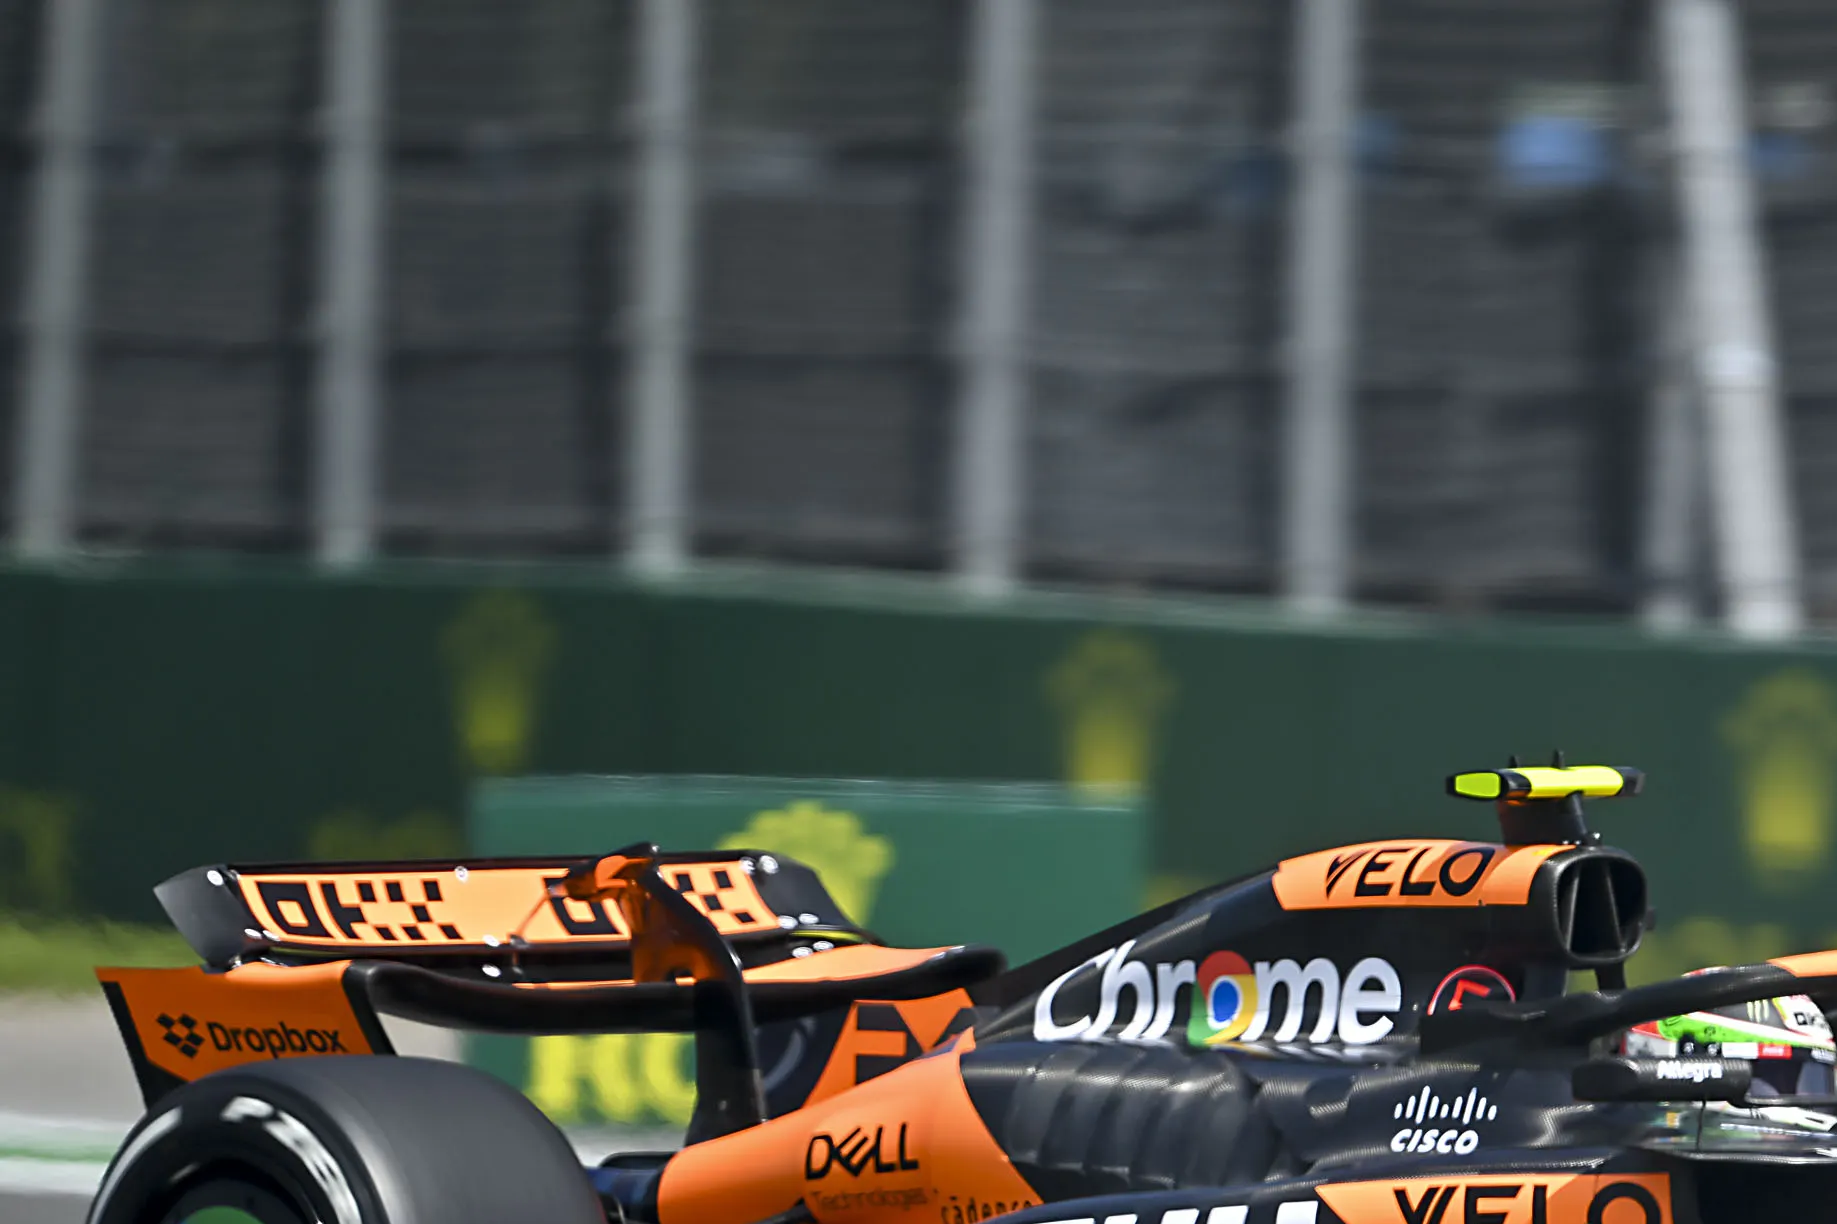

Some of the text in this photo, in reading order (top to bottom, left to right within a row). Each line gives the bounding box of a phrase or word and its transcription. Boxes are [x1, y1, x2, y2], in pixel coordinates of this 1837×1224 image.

[1326, 847, 1496, 899] VELO
[1034, 939, 1401, 1045] Chrome
[207, 1020, 349, 1060] Dropbox
[805, 1122, 919, 1180] DELL
